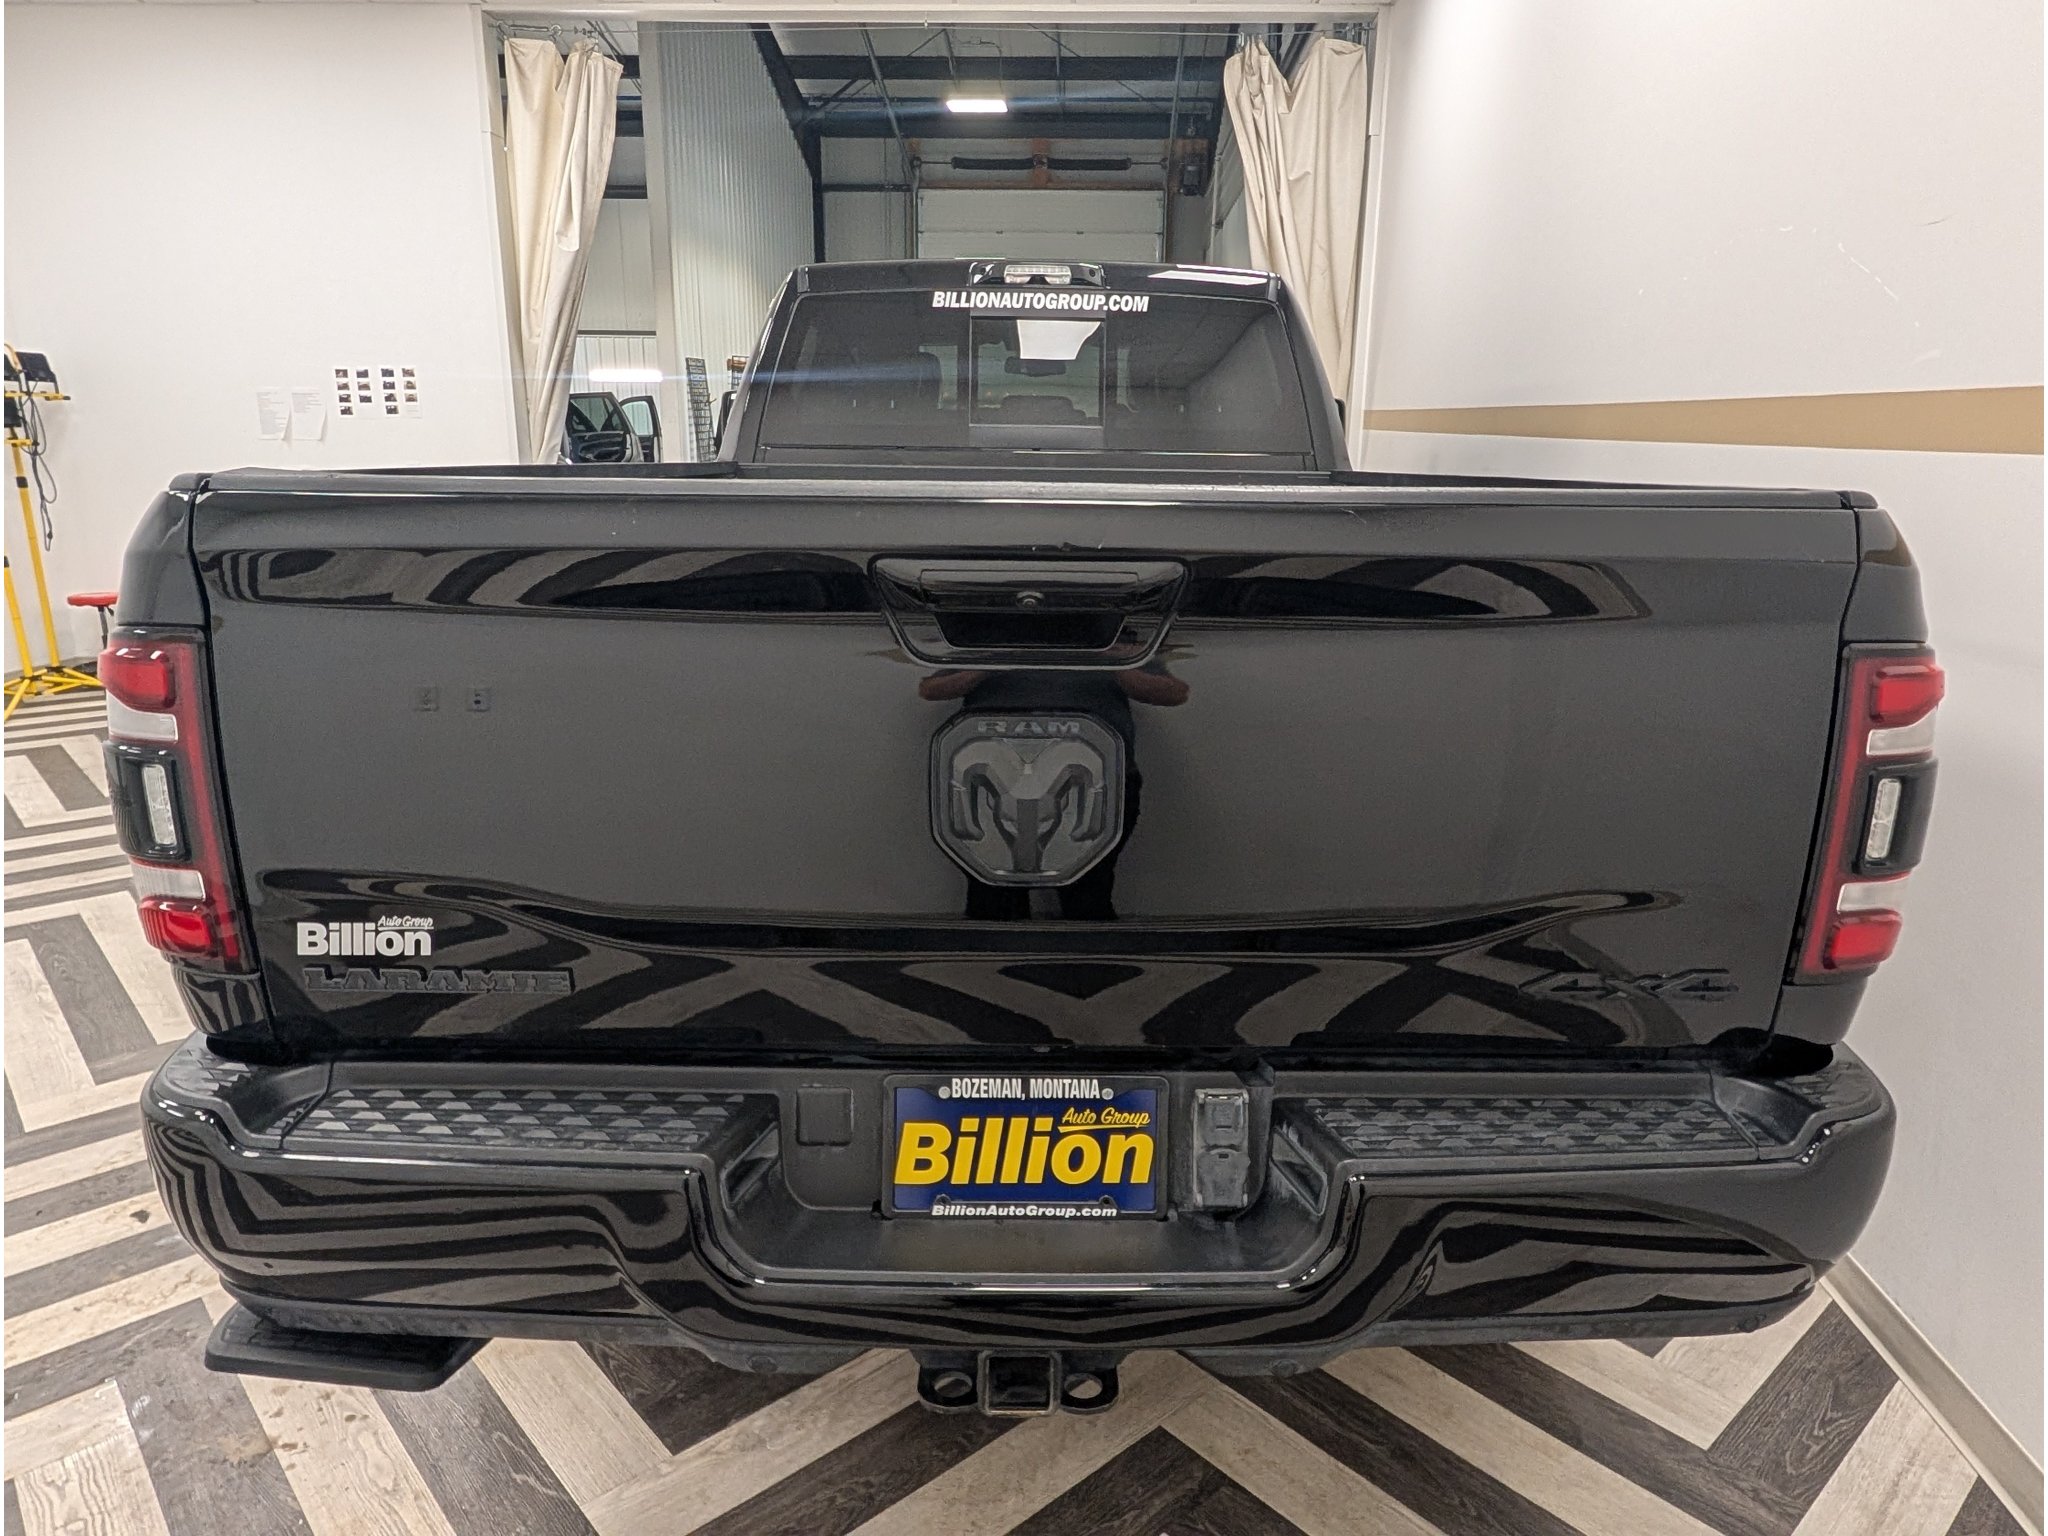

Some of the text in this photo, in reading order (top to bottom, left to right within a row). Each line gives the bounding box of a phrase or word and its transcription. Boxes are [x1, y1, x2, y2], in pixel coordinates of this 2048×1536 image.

[932, 291, 1149, 312] BILLIONAUTOGROUP.COM
[977, 720, 1081, 734] RAM
[377, 915, 434, 929] Auto Group
[297, 922, 431, 956] Billion
[303, 967, 571, 994] LARAMIE
[951, 1078, 1101, 1100] BOZEMAN, MONTANA
[1062, 1107, 1150, 1128] Auto Group
[894, 1117, 1154, 1184] Billion
[931, 1204, 1118, 1218] BillionAutoGroup.com
